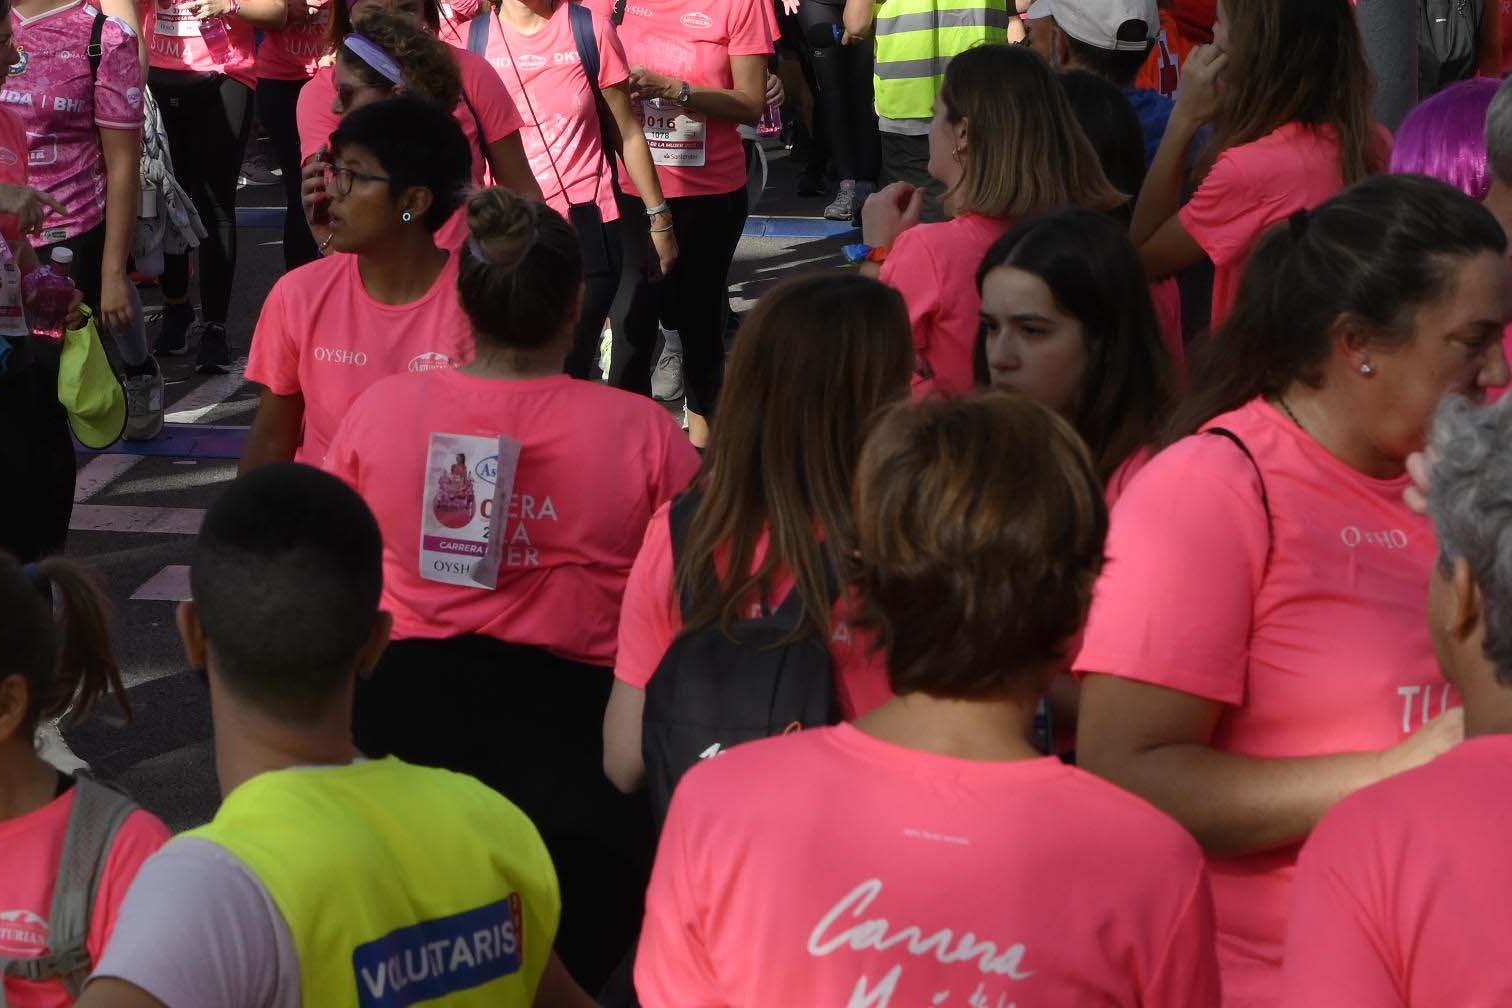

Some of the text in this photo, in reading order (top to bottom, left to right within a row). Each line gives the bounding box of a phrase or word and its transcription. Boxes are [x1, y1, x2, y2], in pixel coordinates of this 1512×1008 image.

[624, 4, 655, 17] YSHO
[313, 347, 368, 367] OYSHO
[439, 541, 483, 553] CARRERA
[434, 560, 471, 575] OYSH
[807, 878, 1033, 981] Carrera
